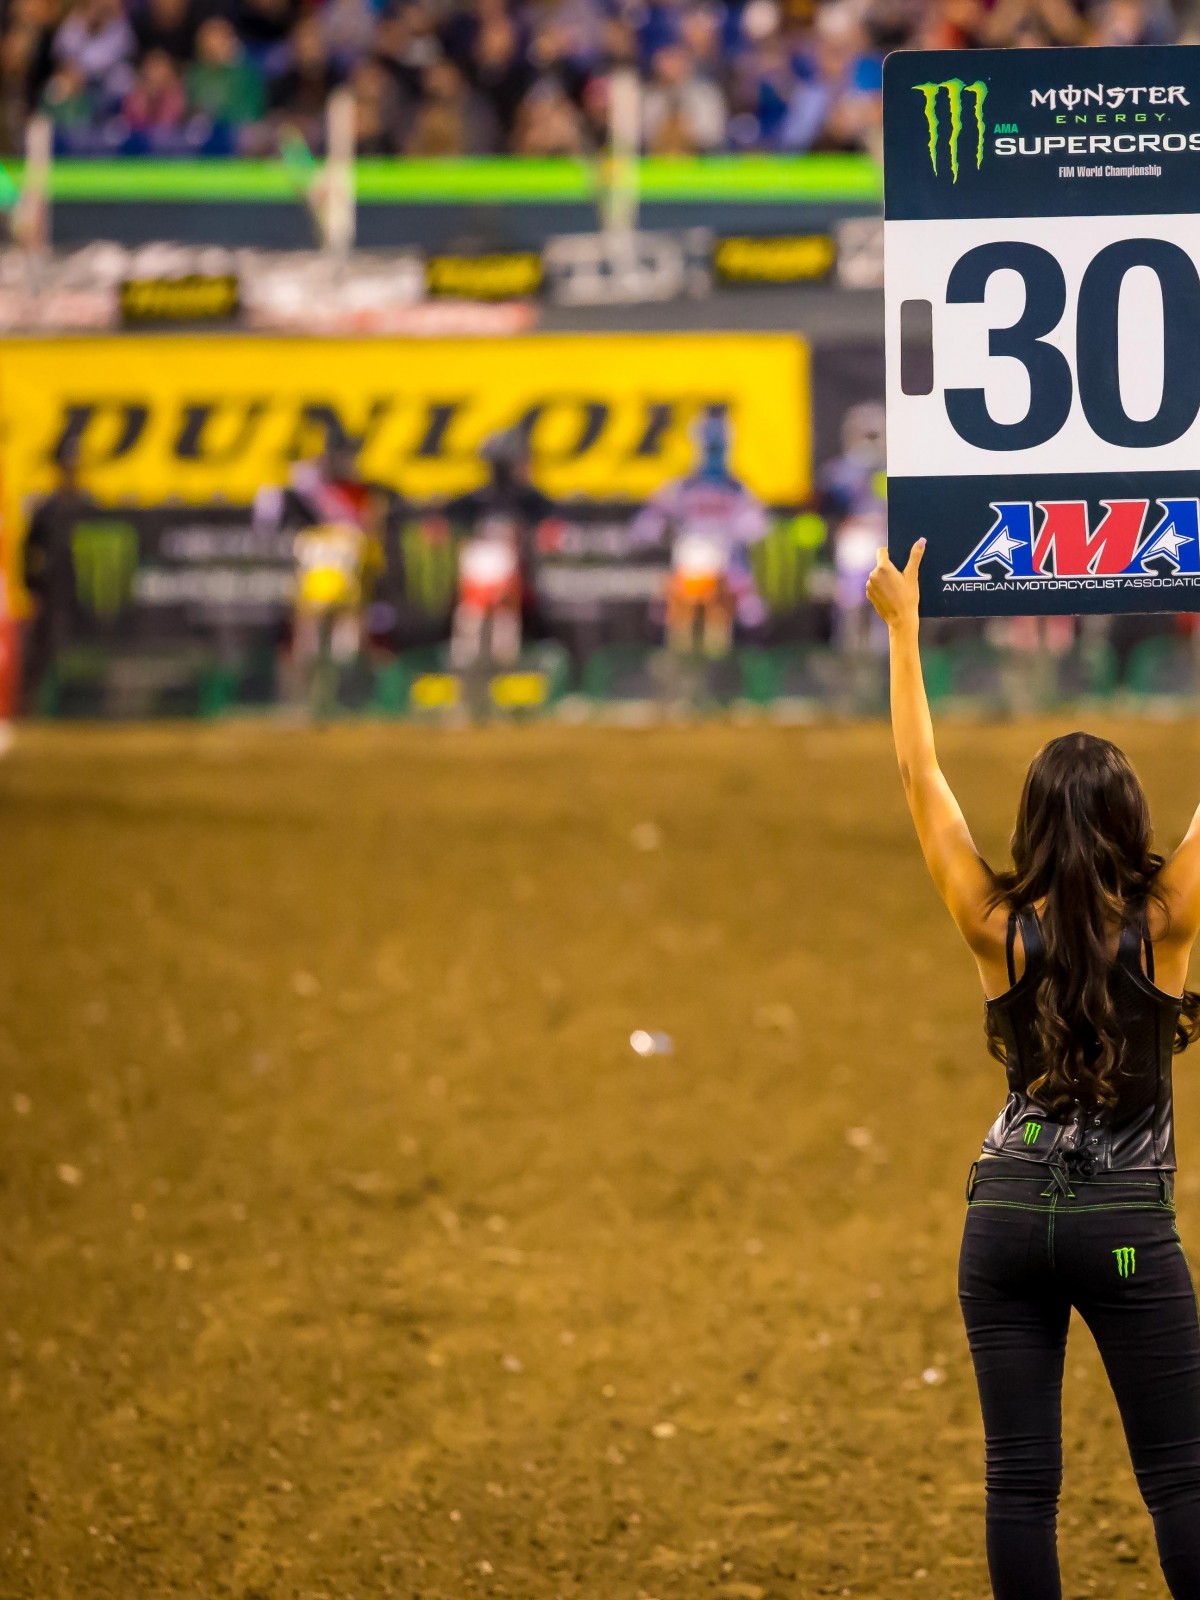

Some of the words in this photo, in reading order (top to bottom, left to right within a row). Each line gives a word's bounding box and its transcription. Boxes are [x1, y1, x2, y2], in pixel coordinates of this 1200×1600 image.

[1030, 84, 1190, 111] MONSTER
[1056, 113, 1166, 124] ENERGY
[994, 123, 1019, 134] AMA
[1058, 166, 1075, 178] FIM
[1077, 166, 1103, 177] World
[1105, 164, 1162, 178] Championship
[943, 582, 1014, 592] AMERICAN
[1016, 580, 1123, 591] MOTORCYCLIST
